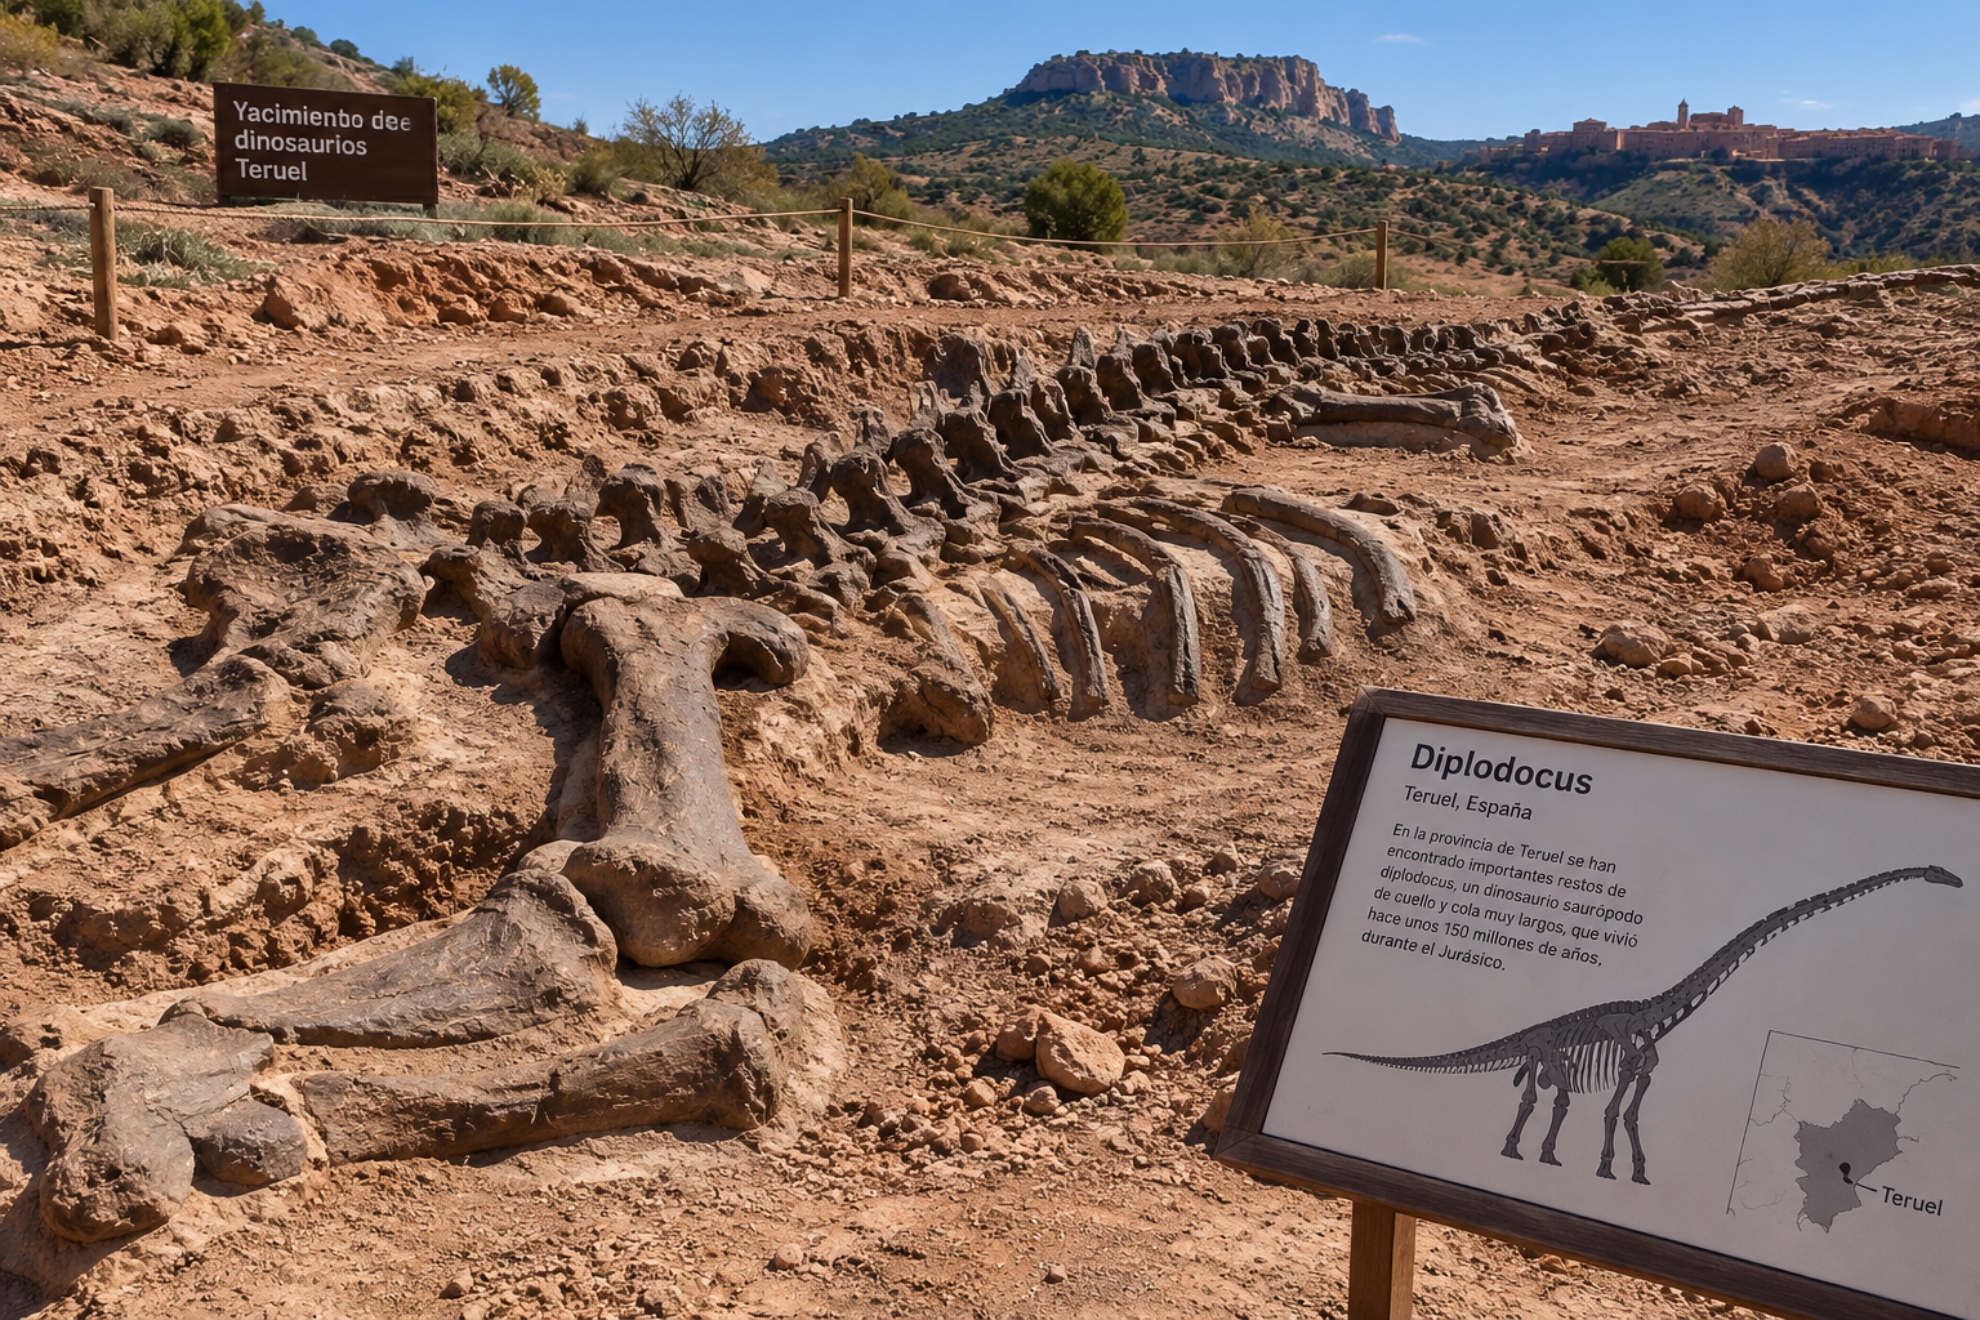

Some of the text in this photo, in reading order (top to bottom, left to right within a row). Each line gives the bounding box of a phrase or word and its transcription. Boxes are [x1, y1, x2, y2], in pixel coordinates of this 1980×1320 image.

[234, 129, 368, 156] dinosaurios
[235, 158, 308, 181] Teruel
[1411, 743, 1593, 794] Diplodocus
[1405, 785, 1532, 820] Teruel, España
[1387, 847, 1626, 898] encontrado importantes restos de
[1393, 823, 1616, 873] En la provincia de Teruel se han
[1374, 887, 1637, 948] de cuello y cola muy largos, que vivió
[1380, 865, 1643, 924] diplodocus, un dinosaurio saurópodo
[1362, 930, 1505, 971] durante el Jurásico.
[1367, 906, 1602, 967] hace unos 150 millones de años,
[1882, 1185, 1943, 1217] Teruel
